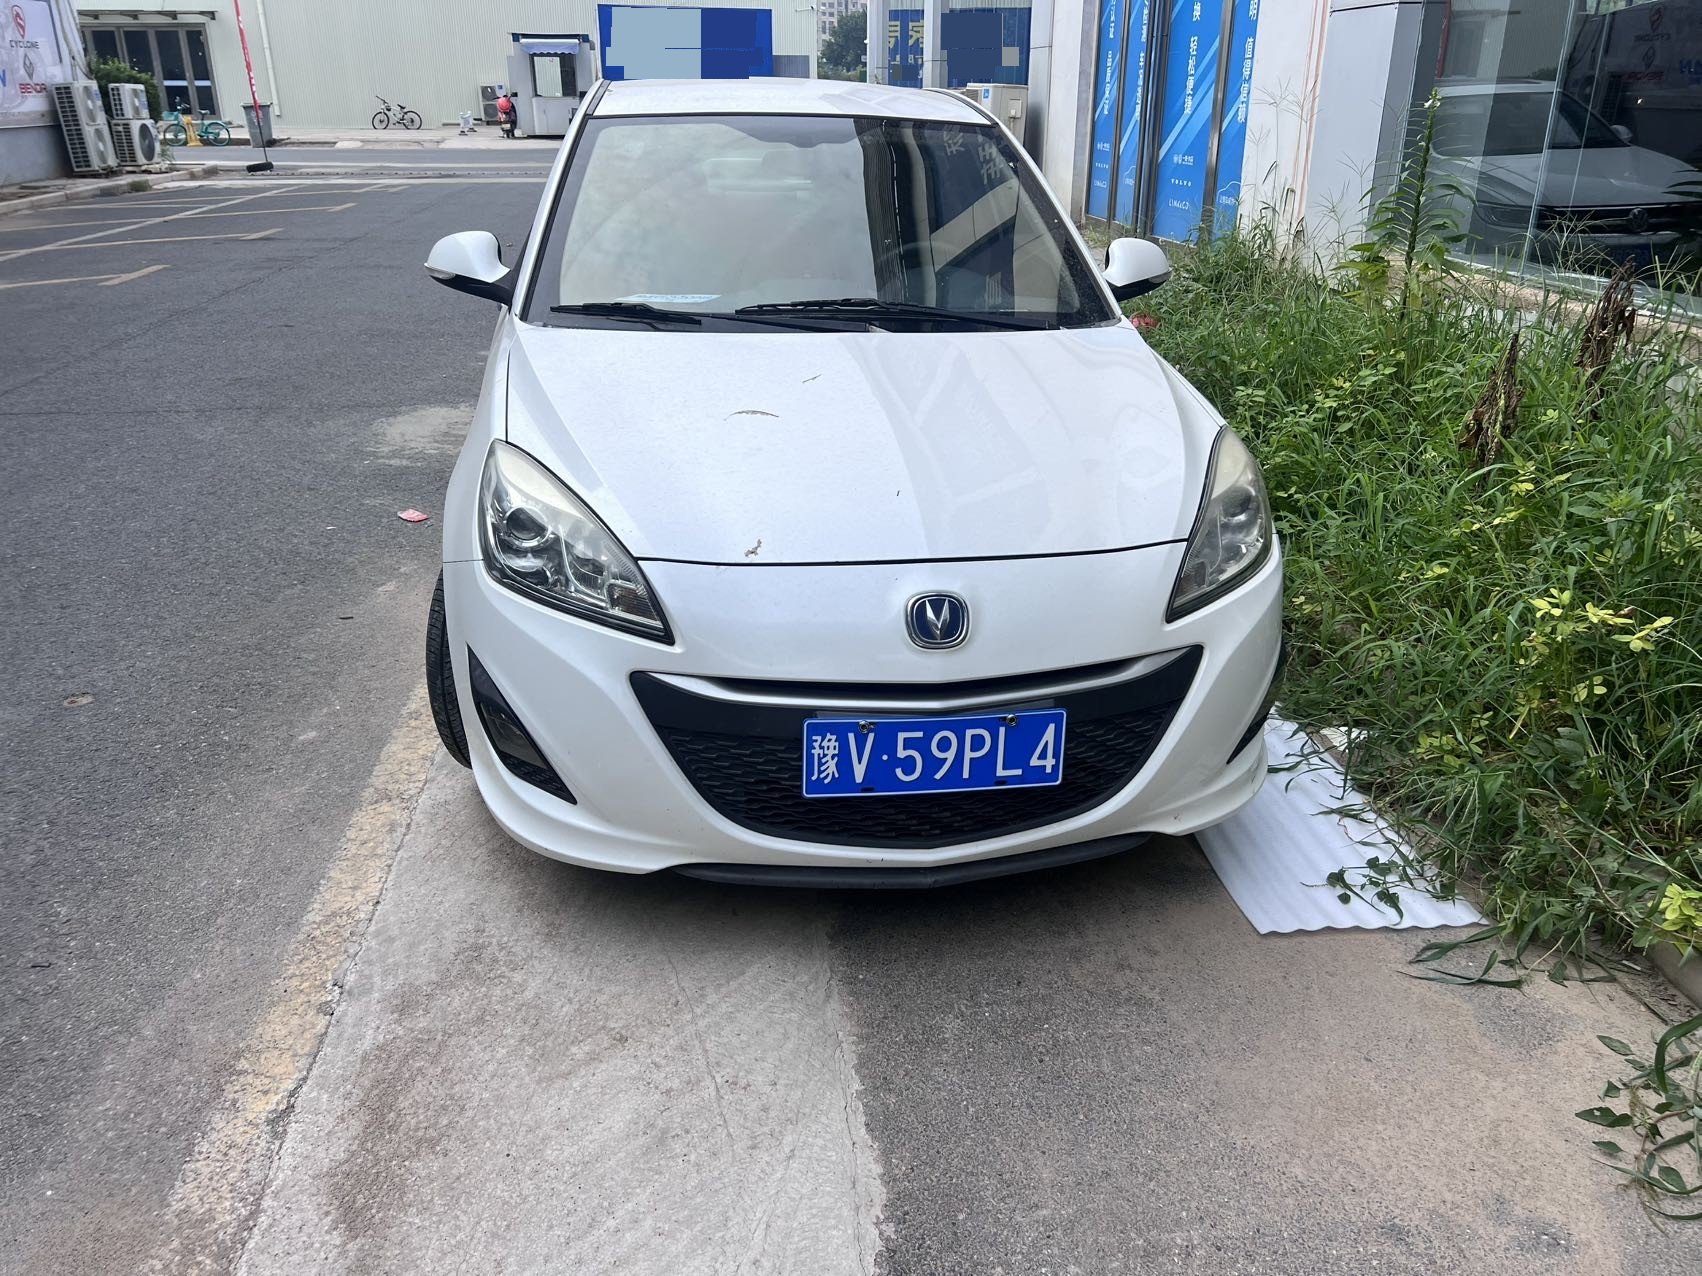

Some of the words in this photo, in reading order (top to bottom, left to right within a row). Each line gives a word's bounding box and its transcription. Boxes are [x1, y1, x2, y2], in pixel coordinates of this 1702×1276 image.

[9, 40, 40, 50] CYCLONE
[1237, 37, 1254, 123] 值得信赖
[1171, 178, 1192, 187] VOLVO
[811, 723, 1056, 784] 豫V·59PL4
